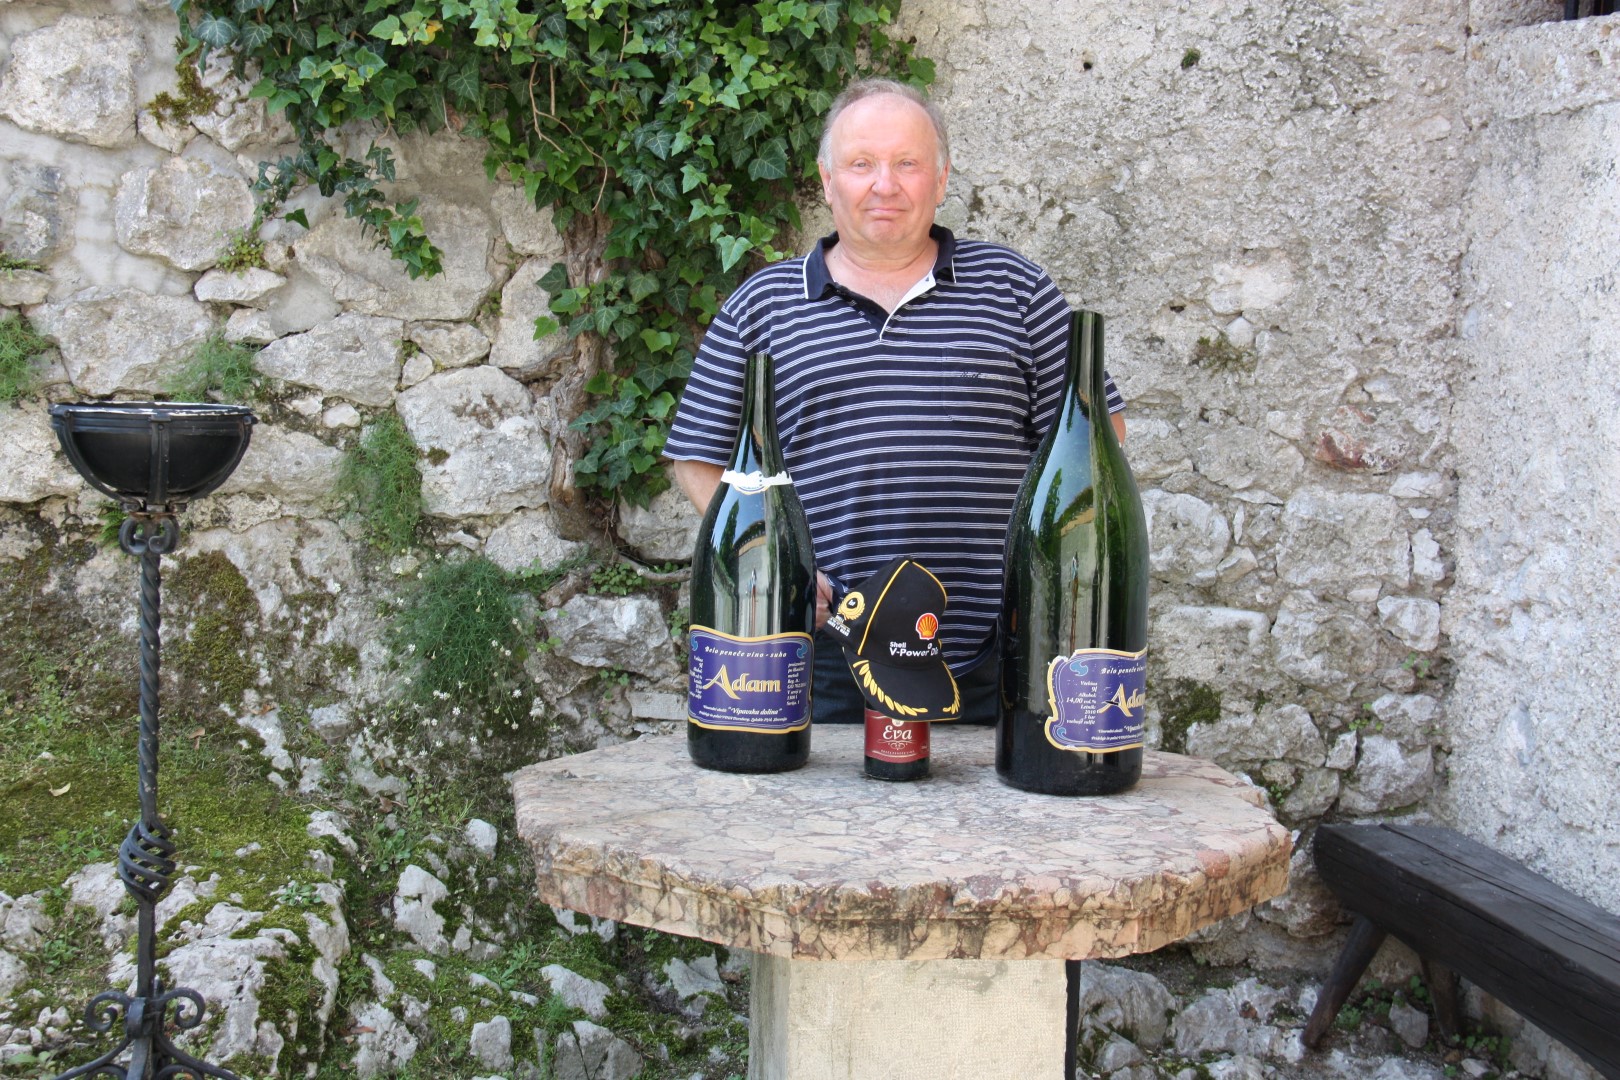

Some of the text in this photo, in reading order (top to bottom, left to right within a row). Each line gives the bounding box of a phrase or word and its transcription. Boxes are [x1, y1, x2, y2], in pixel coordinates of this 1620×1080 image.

[889, 647, 930, 657] V-Power
[703, 664, 782, 700] Adam
[882, 724, 912, 740] Eva
